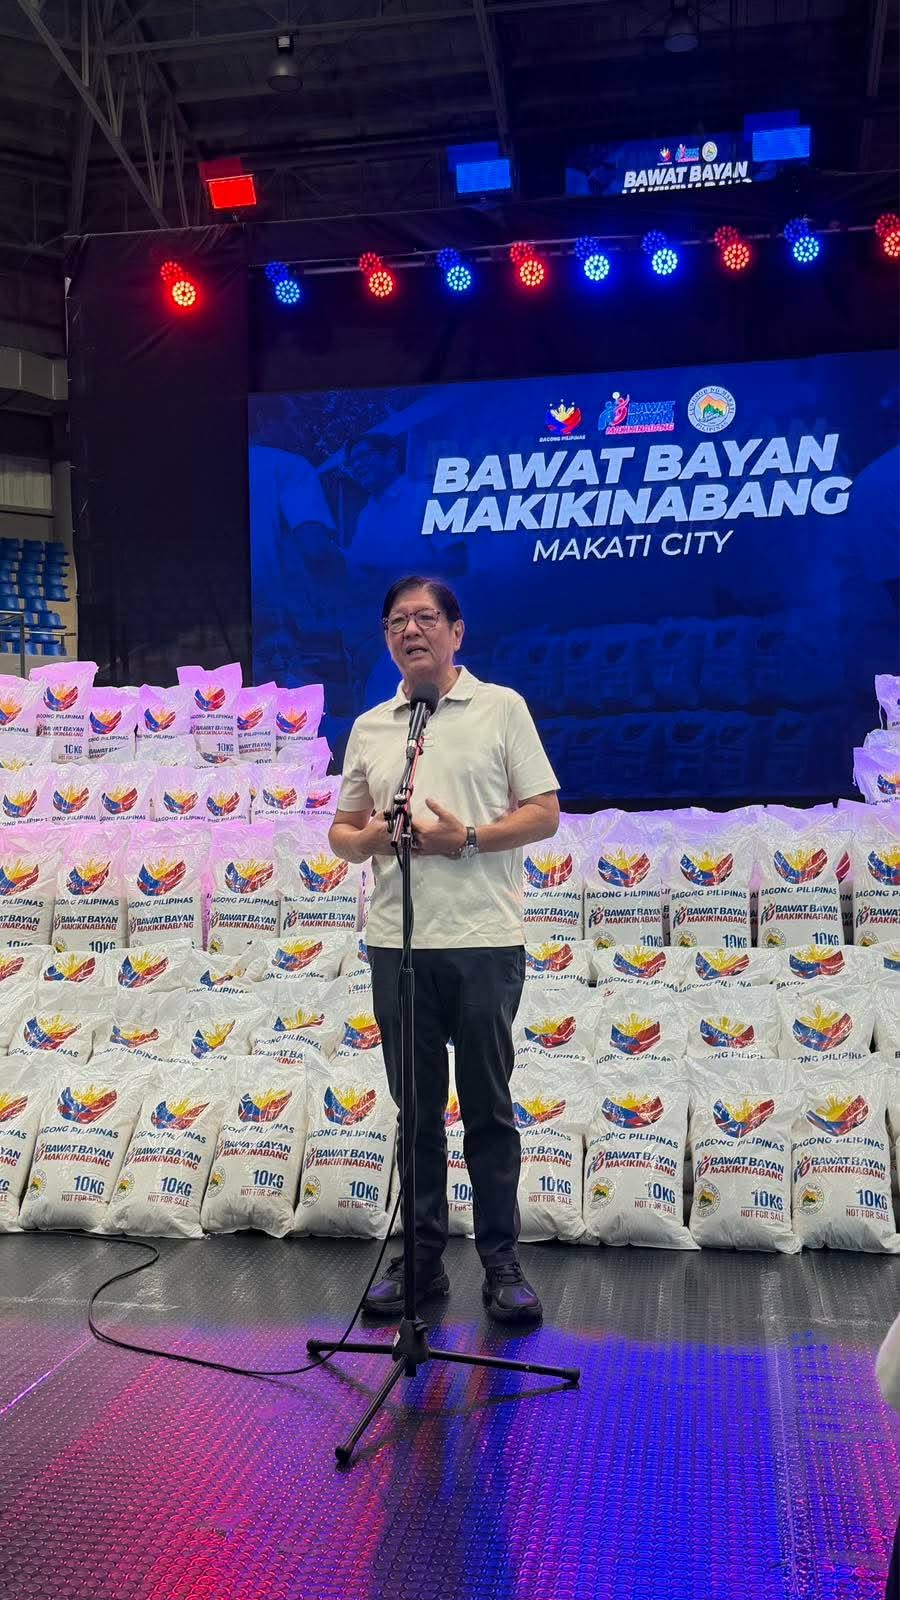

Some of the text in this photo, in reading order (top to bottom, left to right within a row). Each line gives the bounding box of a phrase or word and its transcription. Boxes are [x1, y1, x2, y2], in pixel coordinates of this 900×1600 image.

[624, 167, 688, 188] BAWAT
[689, 161, 748, 182] BAYAN
[433, 434, 839, 493] BAWAT BAYAN
[421, 476, 852, 534] MAKIKINABANG
[532, 530, 734, 562] MAKATI CITY
[586, 890, 622, 900] BAGONG
[672, 889, 704, 901] BAGONG
[706, 889, 748, 899] PILIPINAS
[762, 886, 838, 896] BAGONG PILIPINAS
[856, 890, 889, 898] BAGONG
[2, 898, 44, 908] PILIPINAS
[78, 898, 119, 906] PILIPINAS
[153, 896, 194, 905] PILIPINAS
[238, 897, 279, 907] PILIPINAS
[317, 895, 358, 904] PILIPINAS
[298, 911, 357, 921] BAWAT BAYAN
[549, 907, 580, 919] BAYAN
[604, 908, 661, 918] BAWAT BAYAN
[686, 907, 748, 917] BAWAT BAYAN
[776, 904, 838, 914] BAWAT BAYAN
[776, 911, 838, 921] MAKIKINABANG
[10, 914, 41, 925] BAYAN
[87, 915, 119, 924] BAYAN
[136, 914, 195, 926] BAWAT BAYAN
[219, 912, 277, 925] BAWAT BAYAN
[605, 915, 661, 925] MAKIKINABANG
[686, 915, 747, 925] MAKIKINABANG
[61, 922, 117, 931] MAKIKINABANG
[218, 920, 275, 932] MAKIKINABANG
[640, 934, 664, 948] 10KG
[722, 934, 748, 948] 10KG
[811, 932, 839, 946] 10KG
[70, 1126, 120, 1139] PILIPINAS
[339, 1129, 388, 1142] PILIPINAS
[524, 1127, 572, 1141] PILIPINAS
[628, 1132, 679, 1149] PILIPINAS
[695, 1137, 785, 1152] BAGONG PILIPINAS
[792, 1137, 832, 1152] BAGONG
[45, 1144, 115, 1160] BAWAT BAYAN
[135, 1147, 202, 1164] BAWAT BAYAN
[315, 1148, 385, 1164] BAWAT BAYAN
[537, 1145, 573, 1161] BAYAN
[604, 1150, 641, 1161] BAWAT
[44, 1153, 112, 1168] MAKIKINABANG
[132, 1154, 199, 1171] MAKIKINABANG
[314, 1157, 383, 1172] MAKIKINABANG
[709, 1156, 785, 1175] BAWAT BAYAN
[811, 1156, 886, 1173] BAWAT BAYAN
[253, 1169, 285, 1189] 10KG
[709, 1164, 784, 1182] MAKIKINABANG
[811, 1165, 886, 1182] MAKIKINABANG
[74, 1175, 105, 1196] 10KG
[161, 1176, 193, 1197] 10KG
[349, 1180, 380, 1202] 10KG
[538, 1175, 573, 1195] 10KG
[61, 1193, 74, 1202] NOT
[240, 1188, 253, 1197] NOT
[147, 1194, 191, 1208] NOT FOR SALE
[337, 1200, 351, 1209] NOT
[529, 1194, 573, 1206] NOT FOR SALE
[751, 1189, 784, 1212] 10KG
[856, 1189, 888, 1211] 10KG
[634, 1200, 646, 1209] NOT
[663, 1203, 677, 1216] SALE
[740, 1209, 785, 1223] NOT FOR SALE
[845, 1208, 890, 1223] NOT FOR SALE
